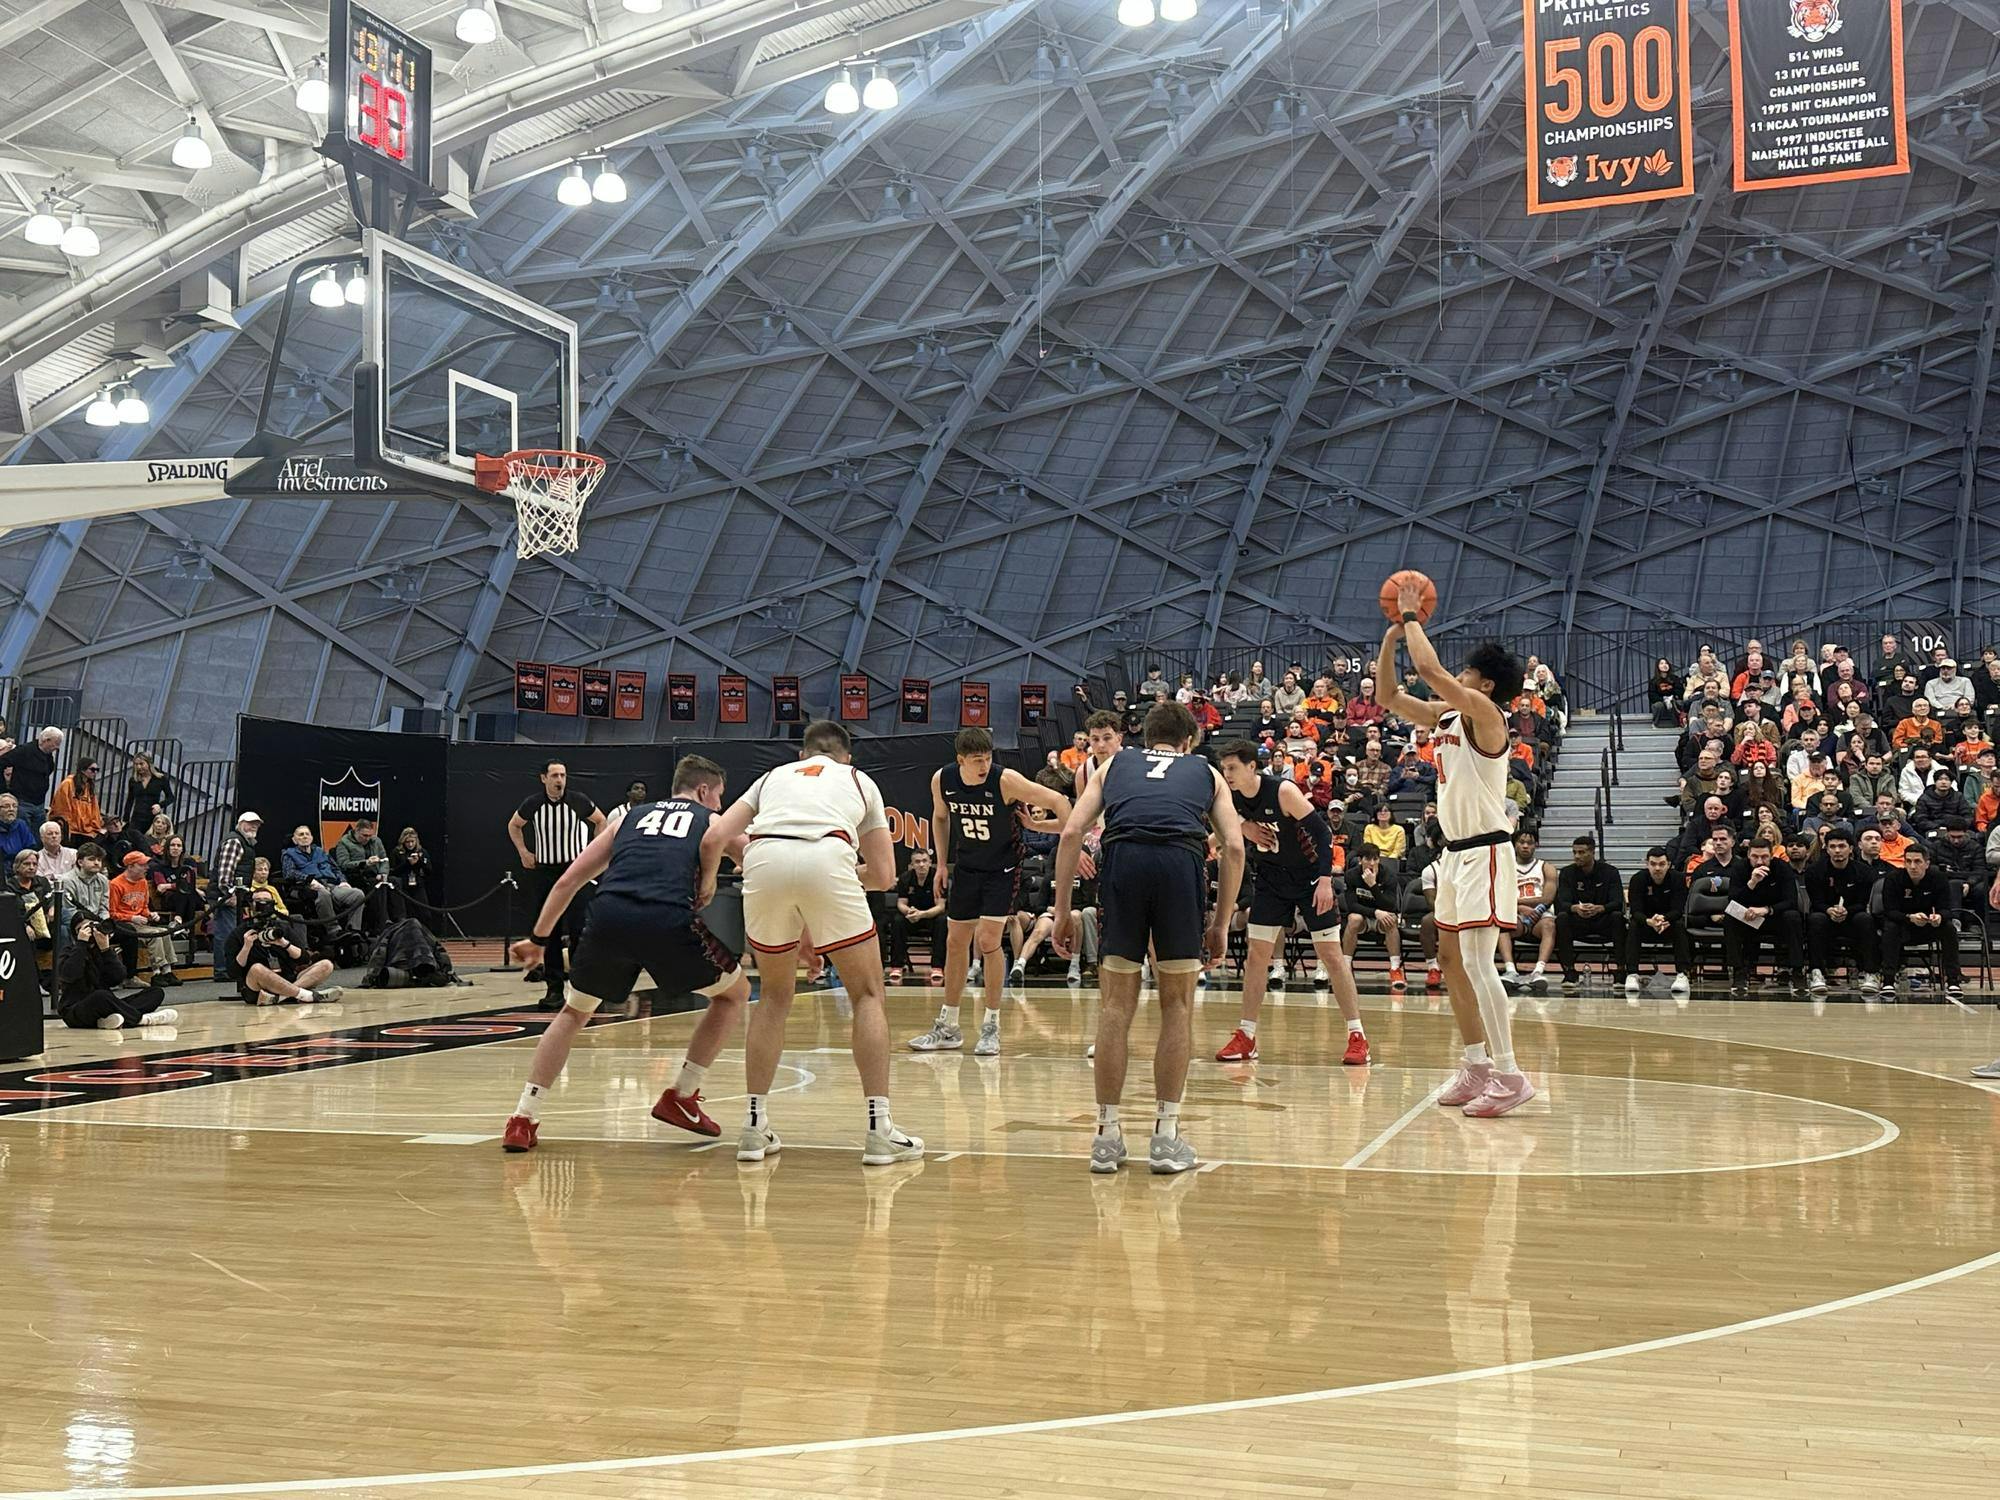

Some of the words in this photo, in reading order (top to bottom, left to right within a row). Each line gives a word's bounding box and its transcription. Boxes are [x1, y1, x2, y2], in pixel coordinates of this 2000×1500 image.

[1563, 3, 1650, 26] ATHLETICS
[1789, 52, 1810, 62] 514
[1812, 47, 1844, 59] WINS
[1544, 26, 1673, 123] 500
[1774, 69, 1788, 80] 13
[1791, 67, 1811, 79] IVY
[1813, 61, 1859, 76] LEAGUE
[1769, 77, 1866, 97] CHAMPIONSHIPS
[1761, 103, 1789, 115] 1975
[1791, 100, 1811, 112] NIT
[1814, 92, 1876, 109] CHAMPION
[1544, 116, 1674, 145] CHAMPIONSHIPS
[1750, 121, 1763, 132] 11
[1766, 117, 1798, 131] NCAA
[1801, 107, 1889, 127] TOURNAMENTS
[1775, 134, 1802, 146] 1997
[1805, 127, 1864, 142] INDUCTEE
[1751, 146, 1808, 161] NAISMITH
[1811, 137, 1889, 154] BASKETBALL
[1585, 154, 1641, 187] Ivy
[1777, 157, 1808, 170] HALL
[1811, 155, 1827, 166] OF
[1830, 152, 1862, 165] FAME
[148, 460, 228, 482] SPALDING
[278, 458, 323, 478] Ariel
[1911, 635, 1945, 652] 106
[1145, 755, 1174, 779] 7
[322, 795, 378, 812] PRINCETON
[655, 800, 691, 810] SMITH
[948, 801, 994, 816] PENN
[635, 810, 695, 838] 40
[961, 818, 990, 841] 25
